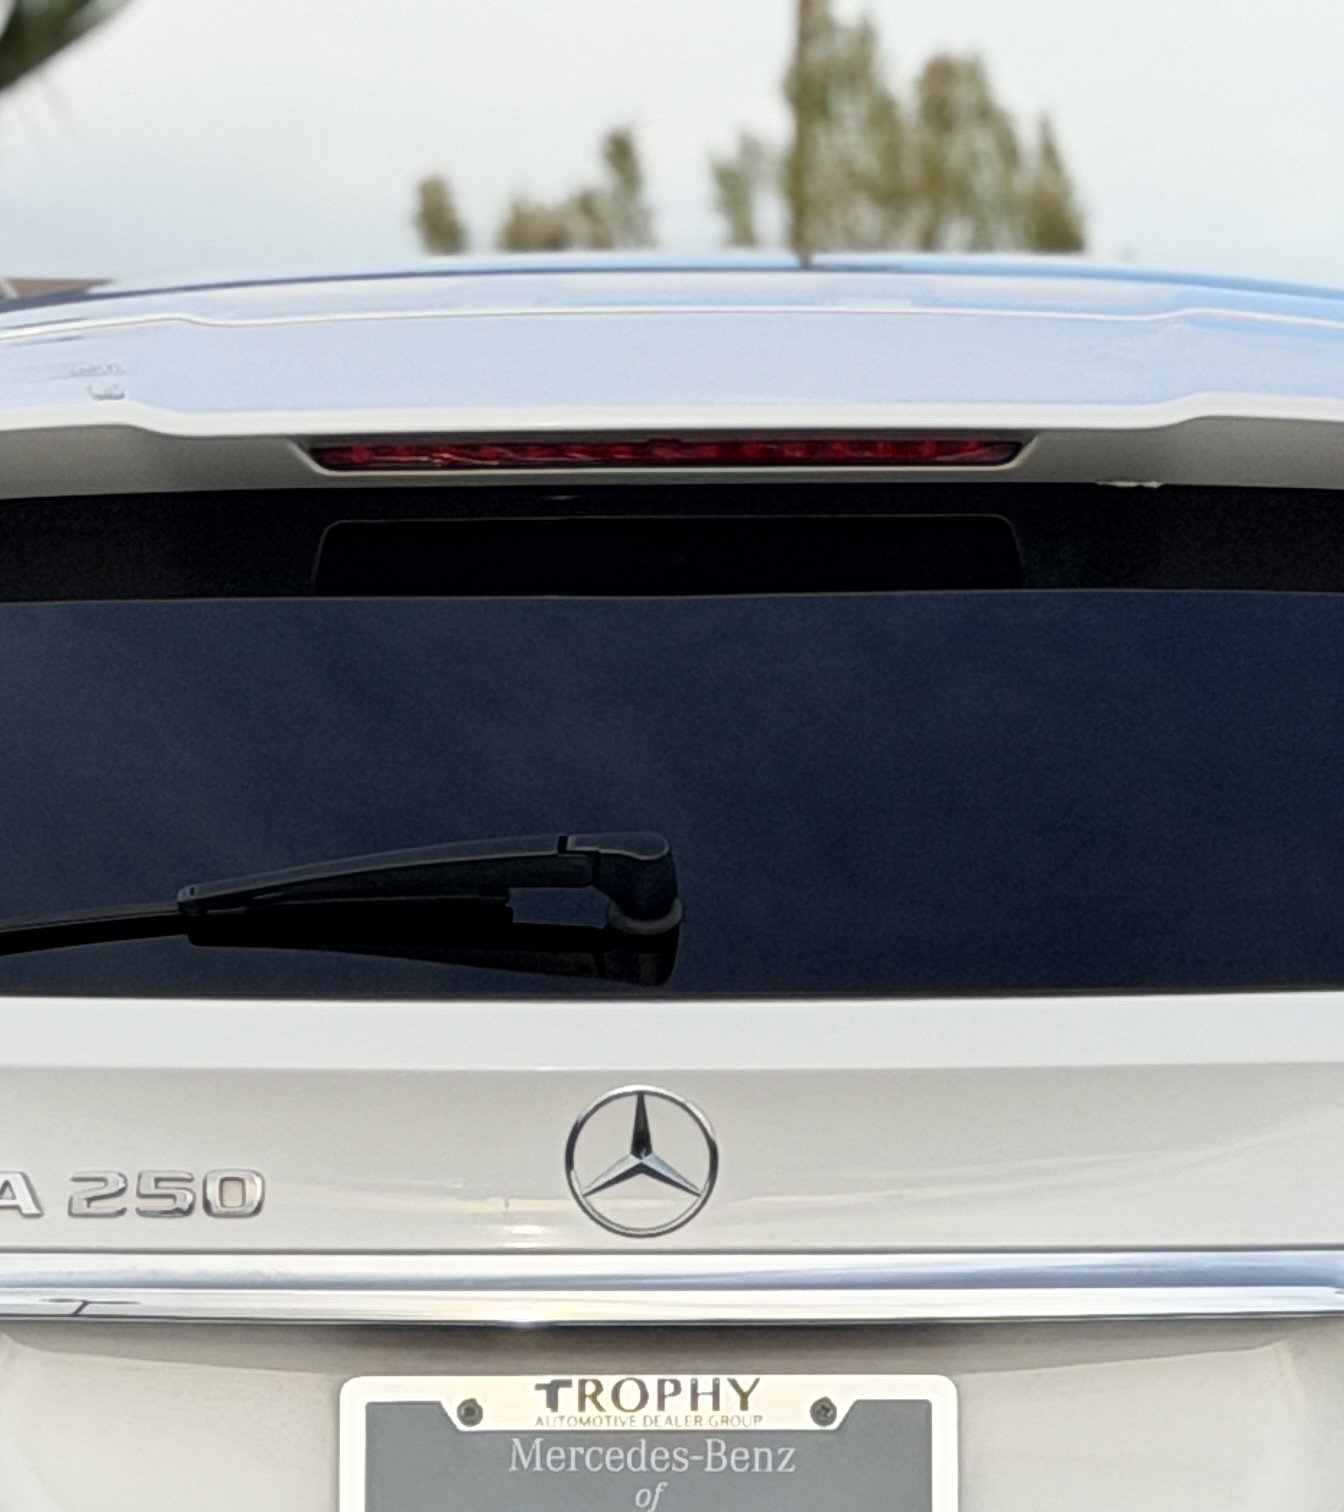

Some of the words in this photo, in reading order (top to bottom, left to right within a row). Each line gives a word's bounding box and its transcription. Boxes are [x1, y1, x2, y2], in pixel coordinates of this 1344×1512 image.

[67, 1169, 265, 1218] 250
[534, 1377, 761, 1413] TROPHY
[535, 1415, 636, 1428] AUTOMOTIVE
[642, 1415, 703, 1428] DEALER
[708, 1415, 764, 1428] GROUP
[508, 1438, 797, 1473] Mercedes-Benz
